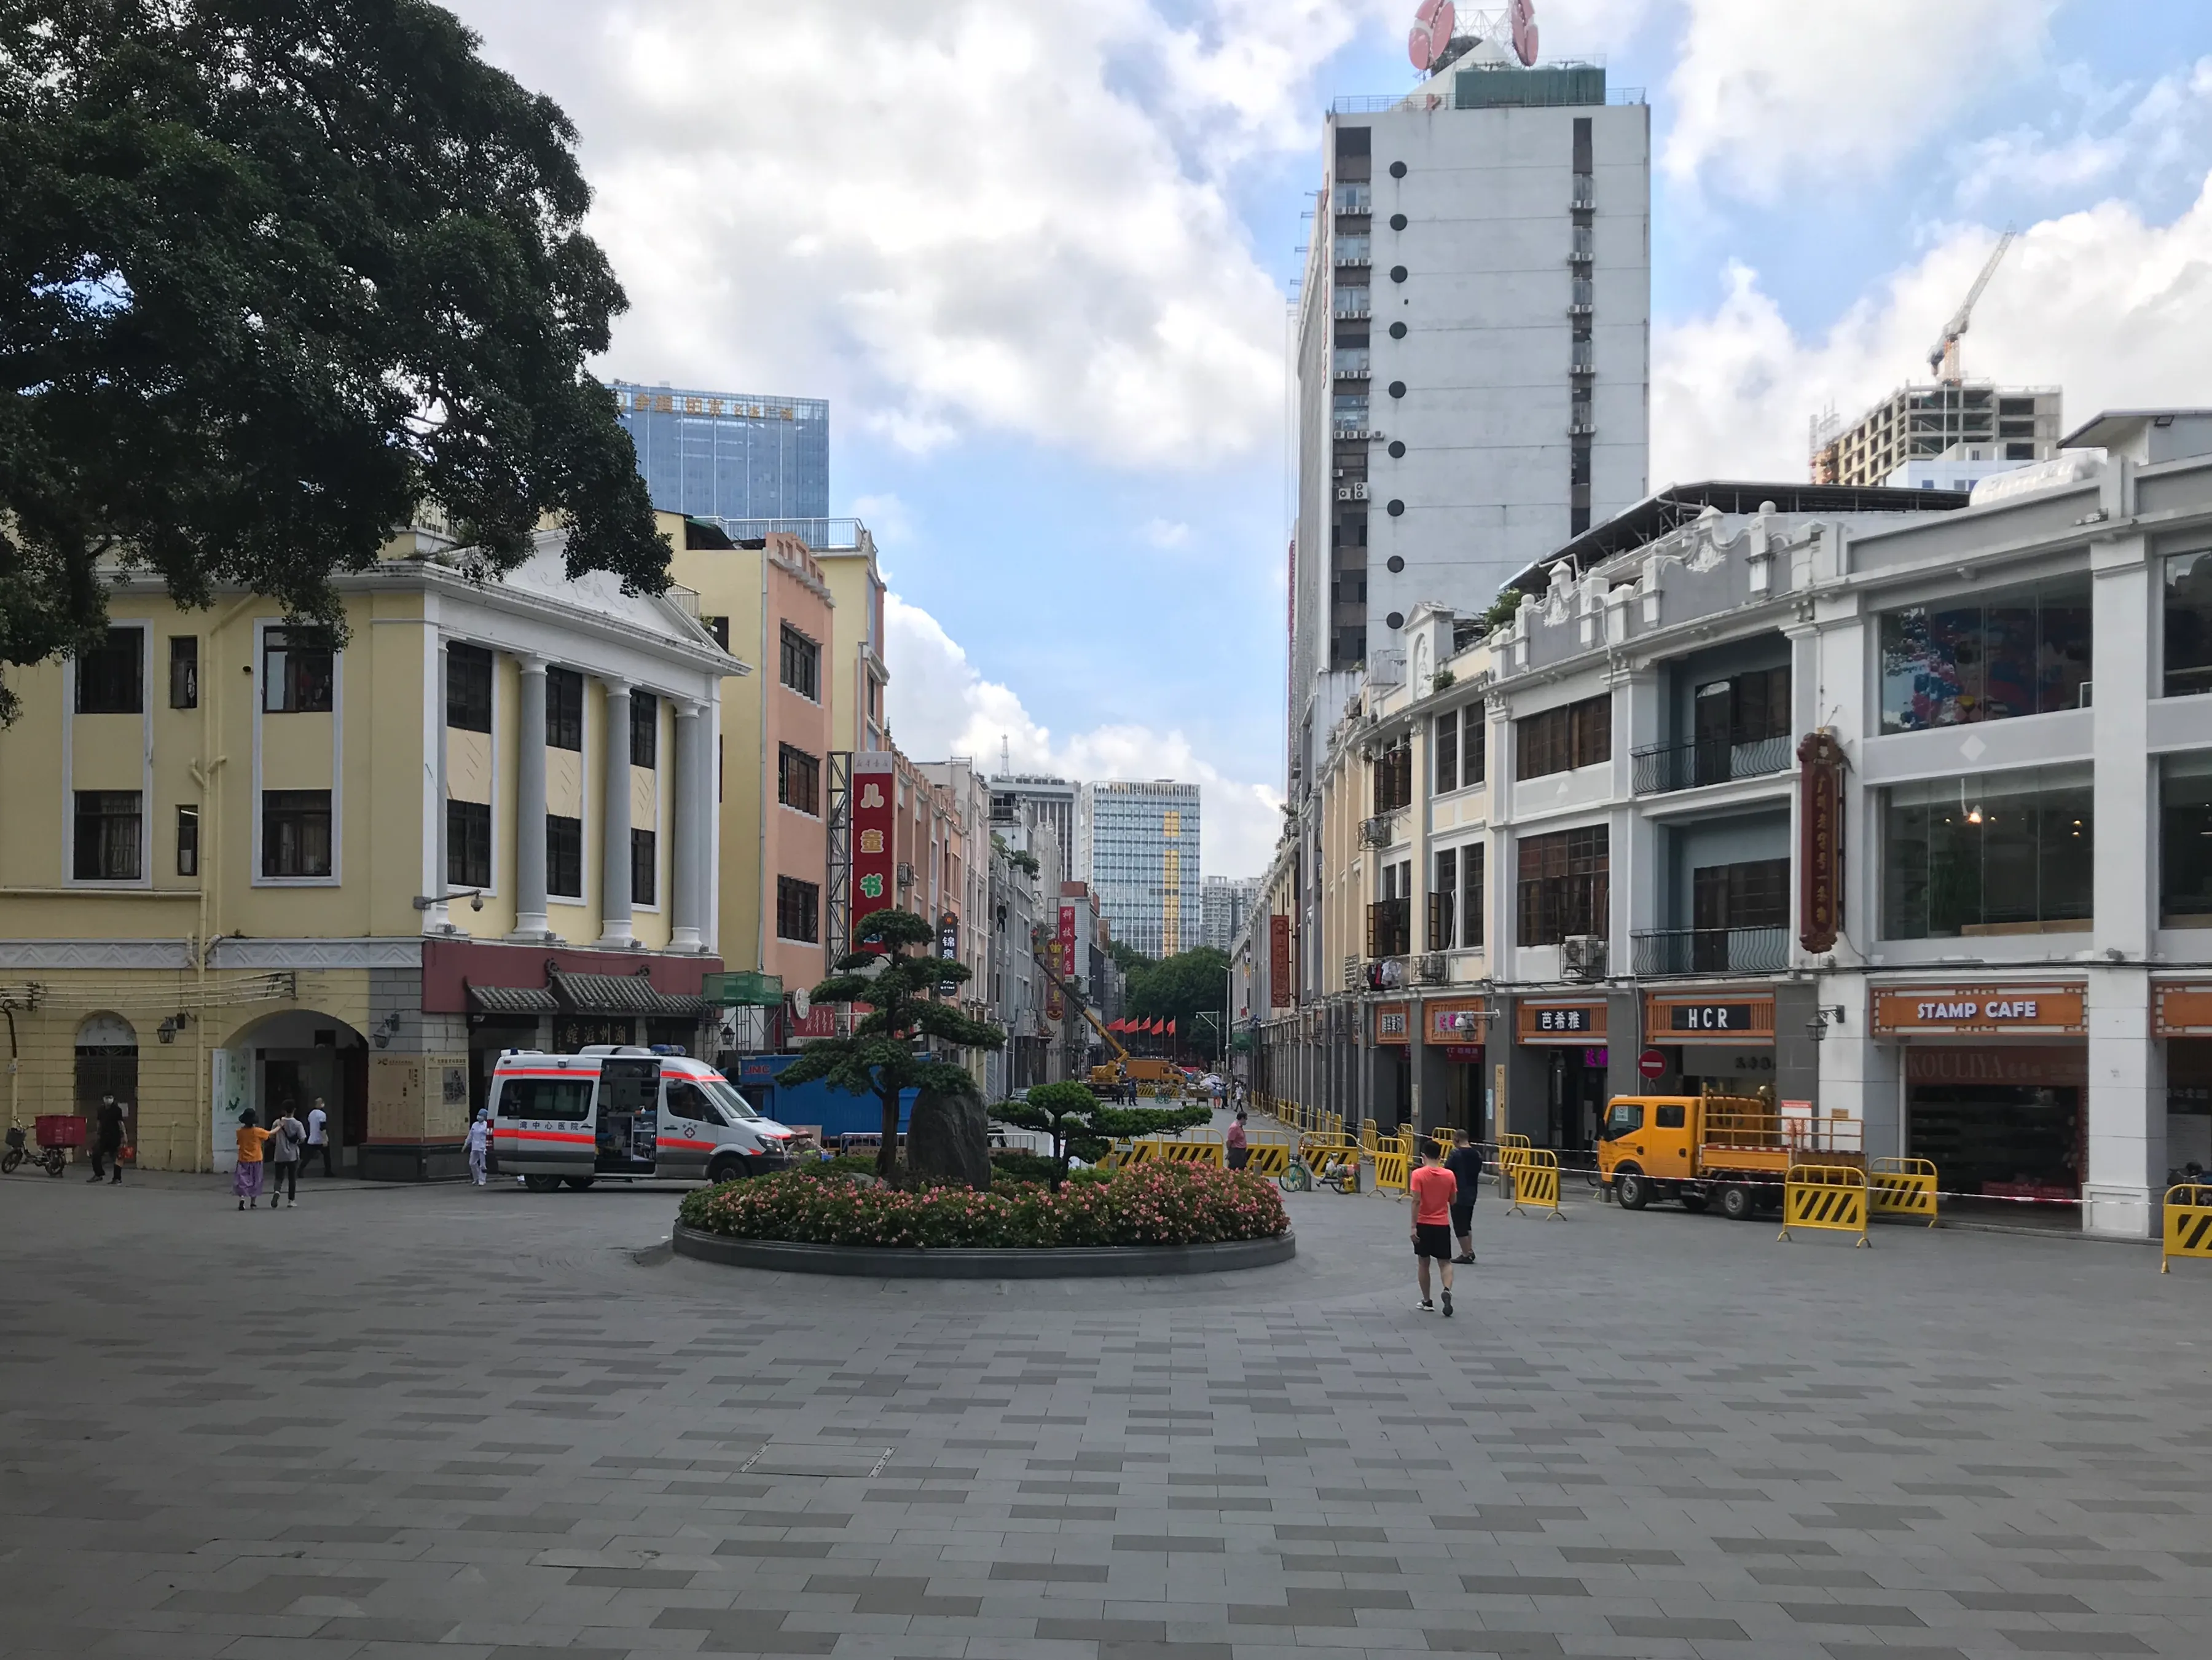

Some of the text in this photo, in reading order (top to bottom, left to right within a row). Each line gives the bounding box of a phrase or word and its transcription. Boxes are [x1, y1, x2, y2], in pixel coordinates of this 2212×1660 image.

[860, 783, 884, 943] 儿童书
[1688, 1007, 1728, 1028] HCR
[1918, 1001, 2036, 1019] STAMP CAFE
[1542, 1011, 1580, 1029] 芭希雅
[744, 1064, 771, 1074] JMC
